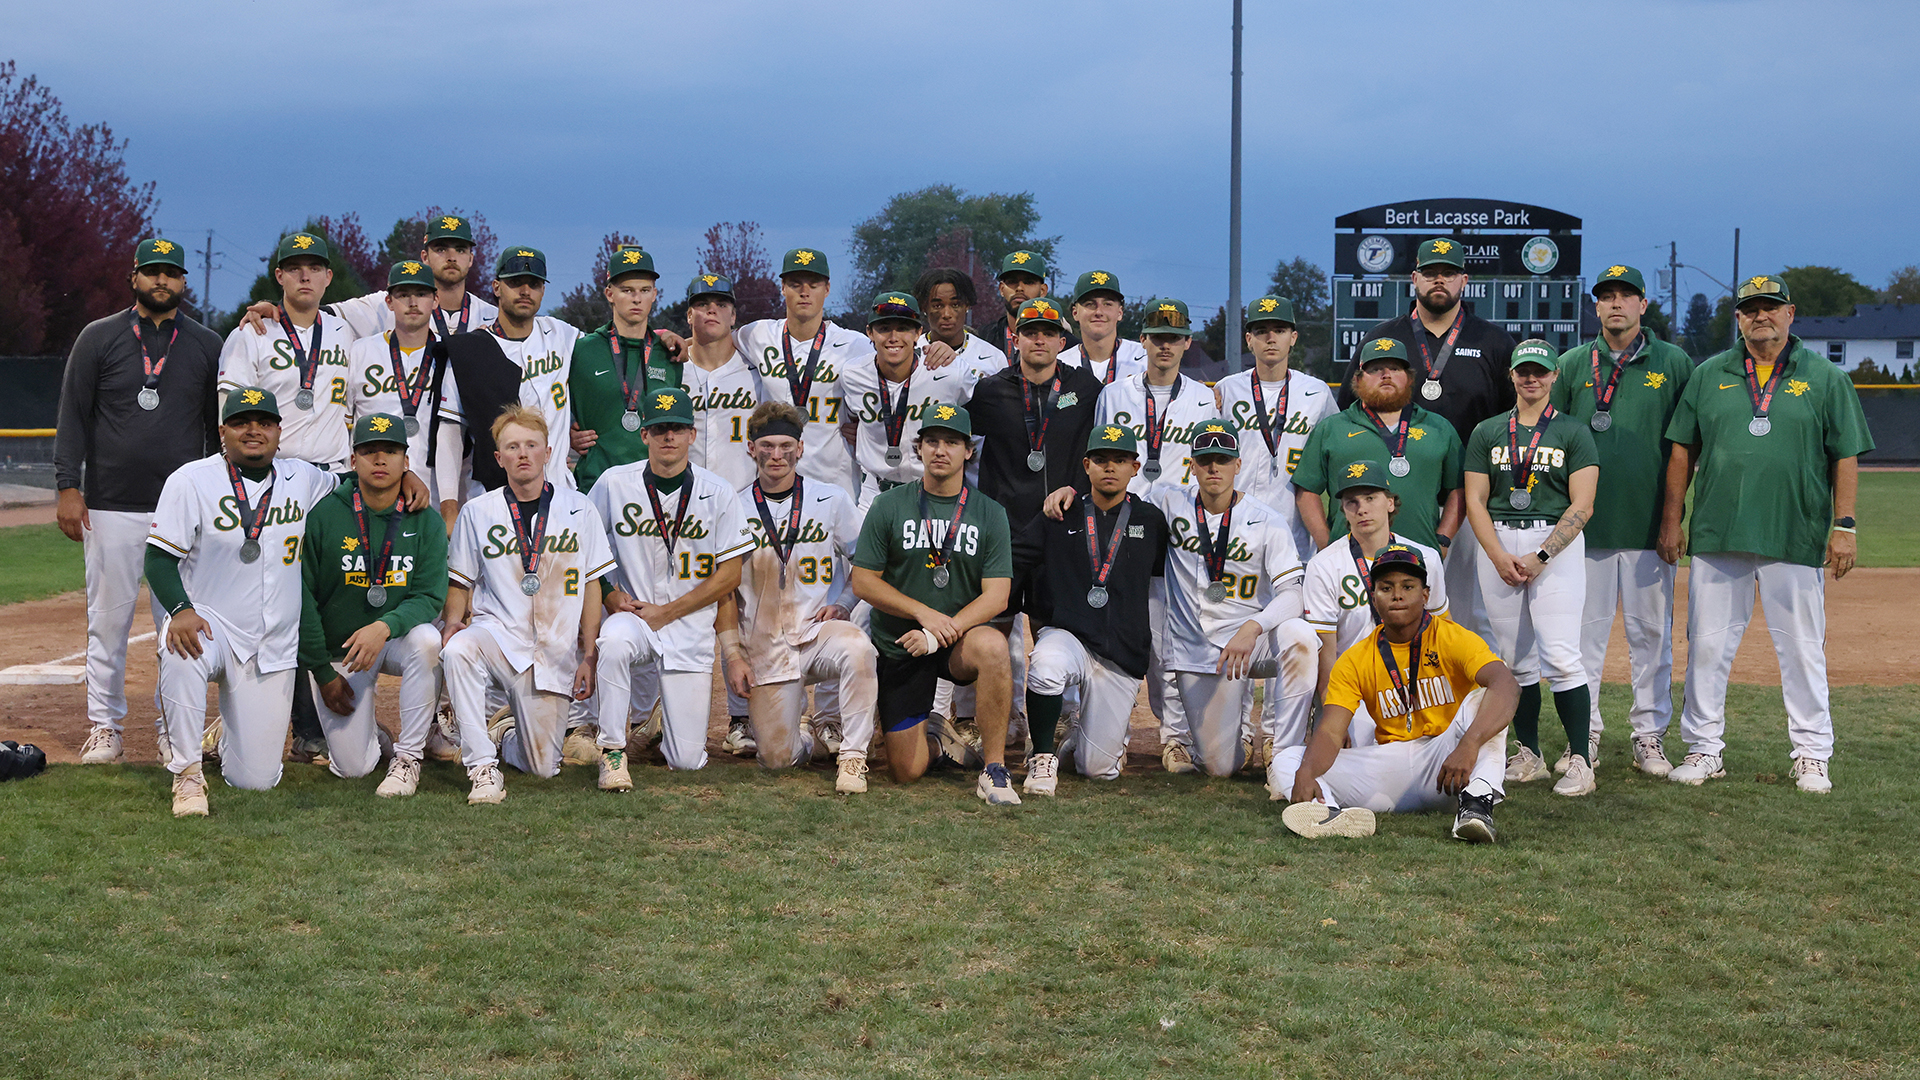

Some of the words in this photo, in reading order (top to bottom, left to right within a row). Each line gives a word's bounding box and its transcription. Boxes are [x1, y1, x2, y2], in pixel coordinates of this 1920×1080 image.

[1385, 208, 1419, 225] Bert
[1425, 208, 1489, 226] Lacasse
[1494, 208, 1530, 226] Park
[1462, 244, 1500, 256] CLAIR
[1351, 283, 1362, 297] AT
[1365, 283, 1383, 297] BAT
[1461, 283, 1486, 298] RIKE
[1503, 284, 1523, 298] OUT
[1541, 284, 1548, 298] H
[1564, 284, 1571, 298] E
[1447, 328, 1459, 346] OCAA
[1530, 323, 1544, 332] HITS
[1553, 323, 1575, 332] ERRORS
[813, 333, 824, 351] OCAA
[1342, 331, 1365, 345] GUE
[269, 338, 348, 371] Snts
[1454, 347, 1481, 358] SAINTS
[1517, 346, 1548, 357] SAINTS
[1745, 358, 1754, 374] OCAA
[362, 364, 431, 398] Sai
[551, 381, 568, 411] 2
[1253, 384, 1261, 402] OCAA
[1603, 385, 1615, 404] OCAA
[809, 396, 842, 424] 17
[1278, 397, 1286, 415] OCAA
[1760, 394, 1772, 412] OCAA
[730, 415, 753, 443] 1
[1152, 431, 1161, 449] OCAA
[1530, 431, 1541, 448] OCAA
[1285, 447, 1303, 475] 5
[1531, 464, 1550, 472] OVE
[235, 481, 246, 501] OCAA
[959, 486, 969, 505] OCAA
[353, 492, 362, 512] OCAA
[510, 502, 521, 520] OCAA
[213, 495, 304, 532] Snts
[791, 510, 799, 529] OCAA
[1087, 516, 1095, 535] OCAA
[483, 524, 579, 559] Sants
[902, 519, 979, 557] SAINTS
[1169, 517, 1253, 562] Sats
[282, 535, 302, 566] 3
[341, 554, 414, 573] SATS
[528, 552, 538, 571] OCAA
[679, 551, 715, 580] 13
[799, 556, 833, 585] 33
[1356, 558, 1368, 576] OCAA
[564, 567, 580, 596] 2
[1098, 563, 1110, 582] OCAA
[1222, 572, 1259, 600] 20
[1390, 669, 1402, 690] OCAA
[1377, 674, 1456, 719] ASSATION
